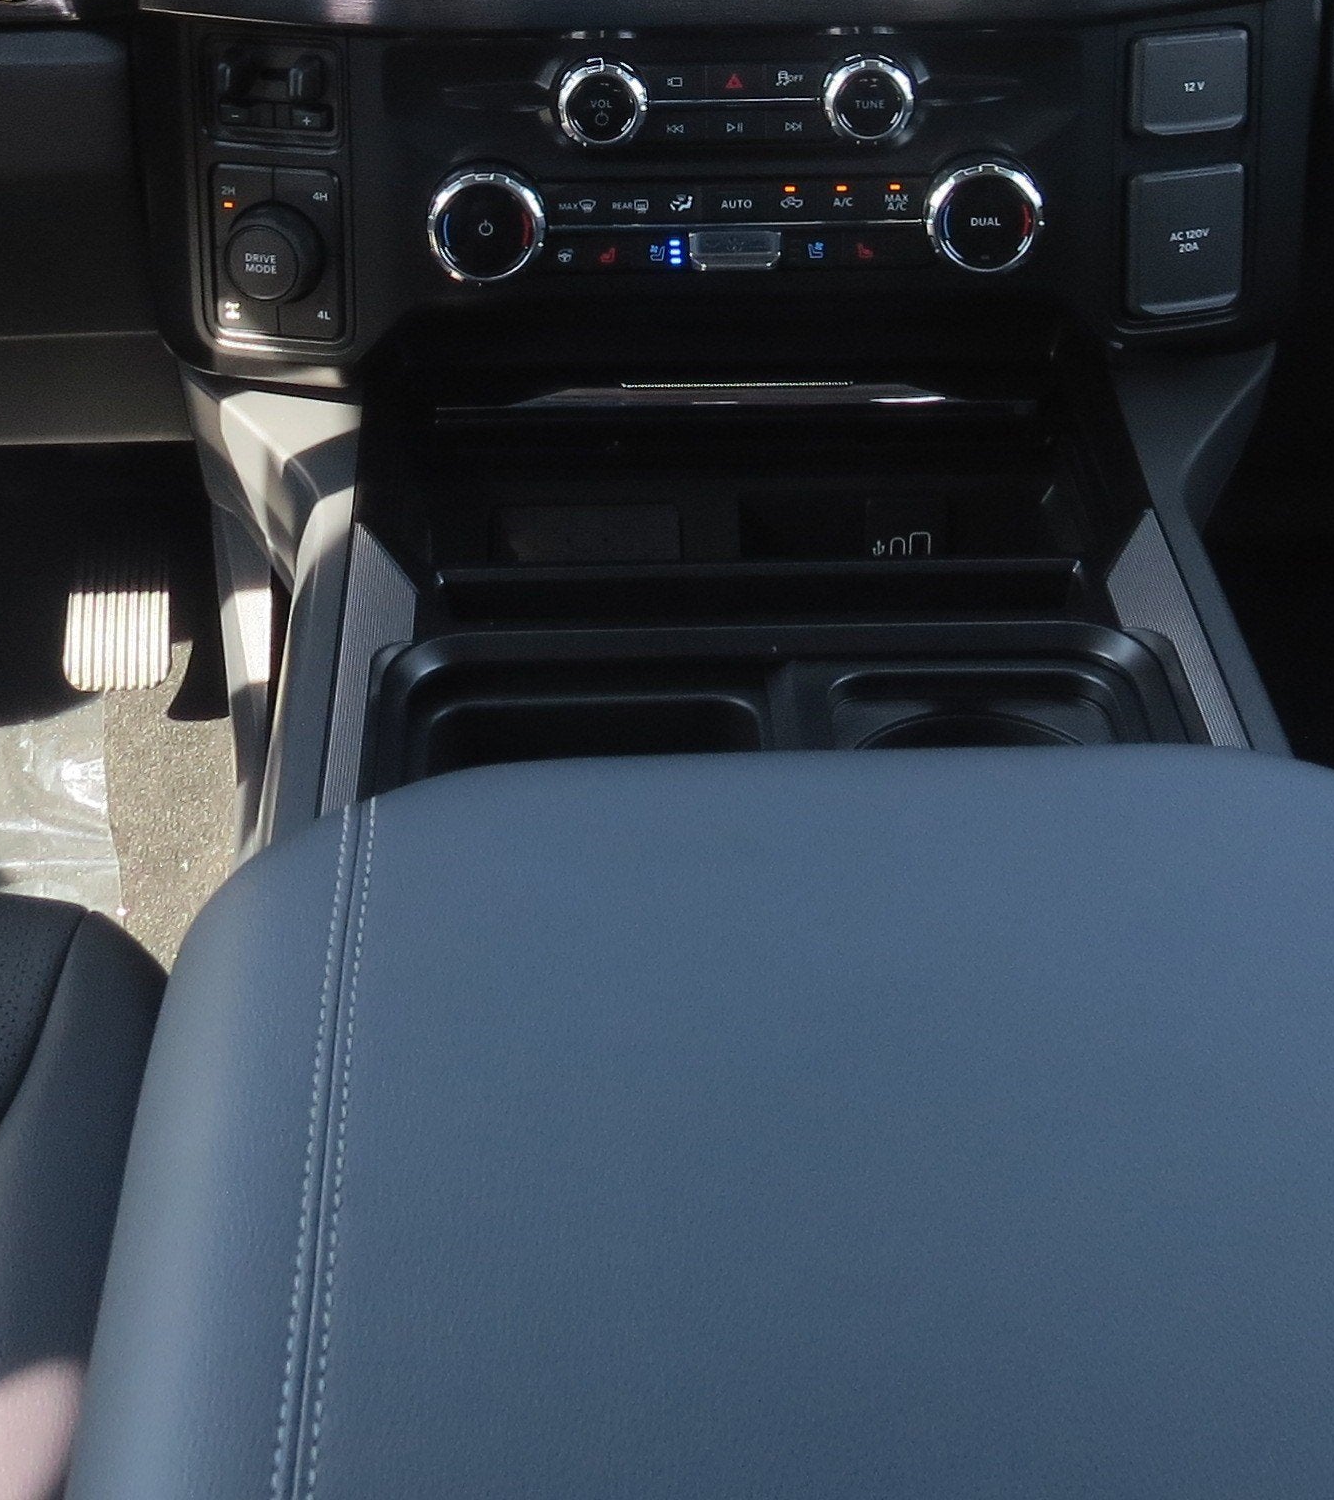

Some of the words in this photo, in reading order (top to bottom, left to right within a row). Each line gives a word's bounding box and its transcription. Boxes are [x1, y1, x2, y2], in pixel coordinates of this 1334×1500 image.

[590, 99, 613, 110] VOL
[853, 99, 886, 110] TUNE
[220, 185, 236, 196] 2H
[312, 191, 328, 202] 4H
[832, 196, 854, 208] A/C
[884, 193, 910, 203] MAX
[558, 201, 579, 211] MAX
[611, 201, 634, 211] REAR
[720, 198, 753, 210] AUTO
[886, 202, 908, 212] A/C
[970, 216, 1002, 227] DUAL
[1169, 231, 1185, 242] AC
[1185, 227, 1210, 241] 120V
[1178, 241, 1200, 253] 20A
[244, 252, 278, 264] DRIVE
[245, 263, 278, 275] MODE
[316, 310, 331, 321] 4L
